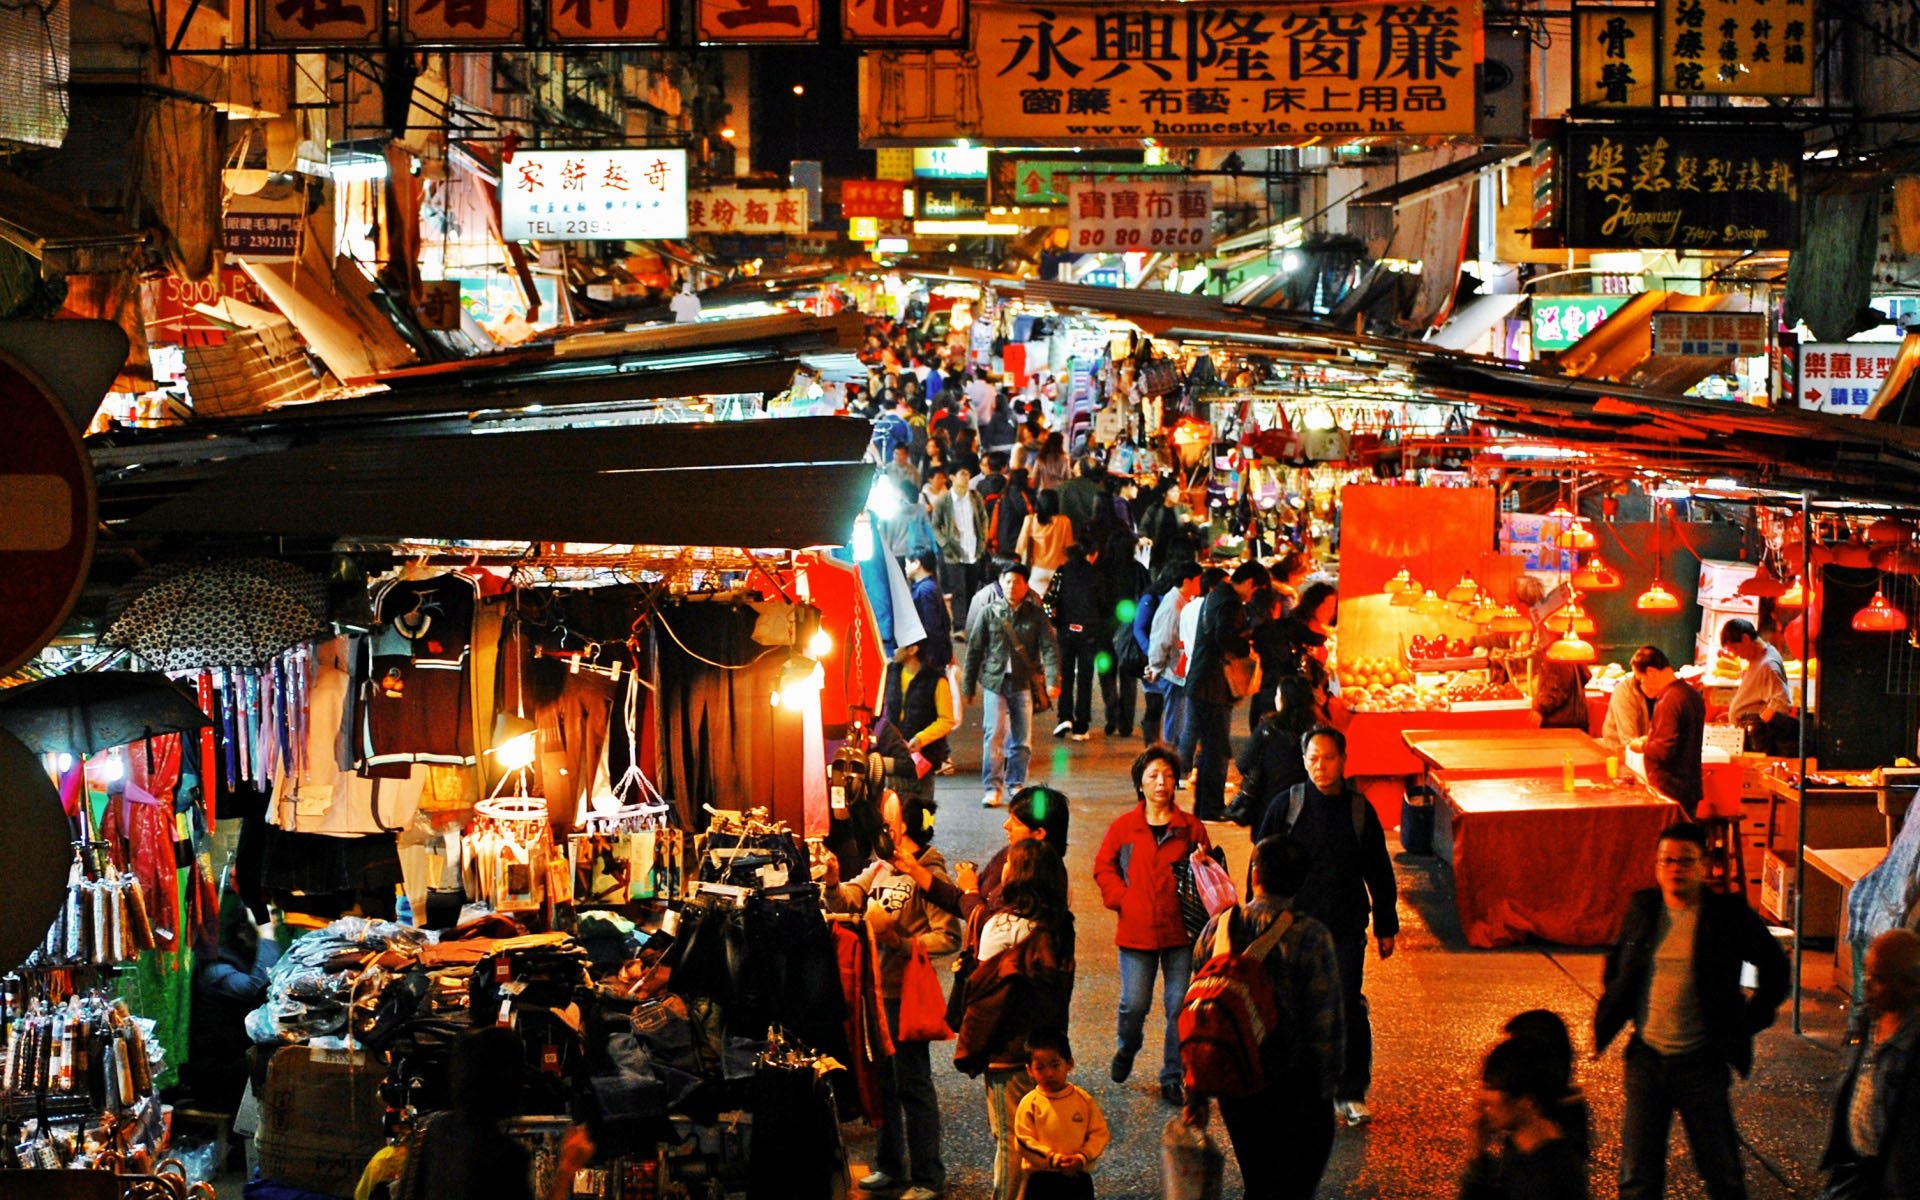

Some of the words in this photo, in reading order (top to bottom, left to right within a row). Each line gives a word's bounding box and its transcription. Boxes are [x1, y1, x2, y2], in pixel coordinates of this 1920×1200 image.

[996, 5, 1462, 82] 永興隆窗簾
[1597, 17, 1636, 103] 骨醫
[1079, 229, 1105, 246] BO
[1115, 229, 1141, 246] BO
[1151, 228, 1204, 246] DECO
[1722, 224, 1768, 246] Design
